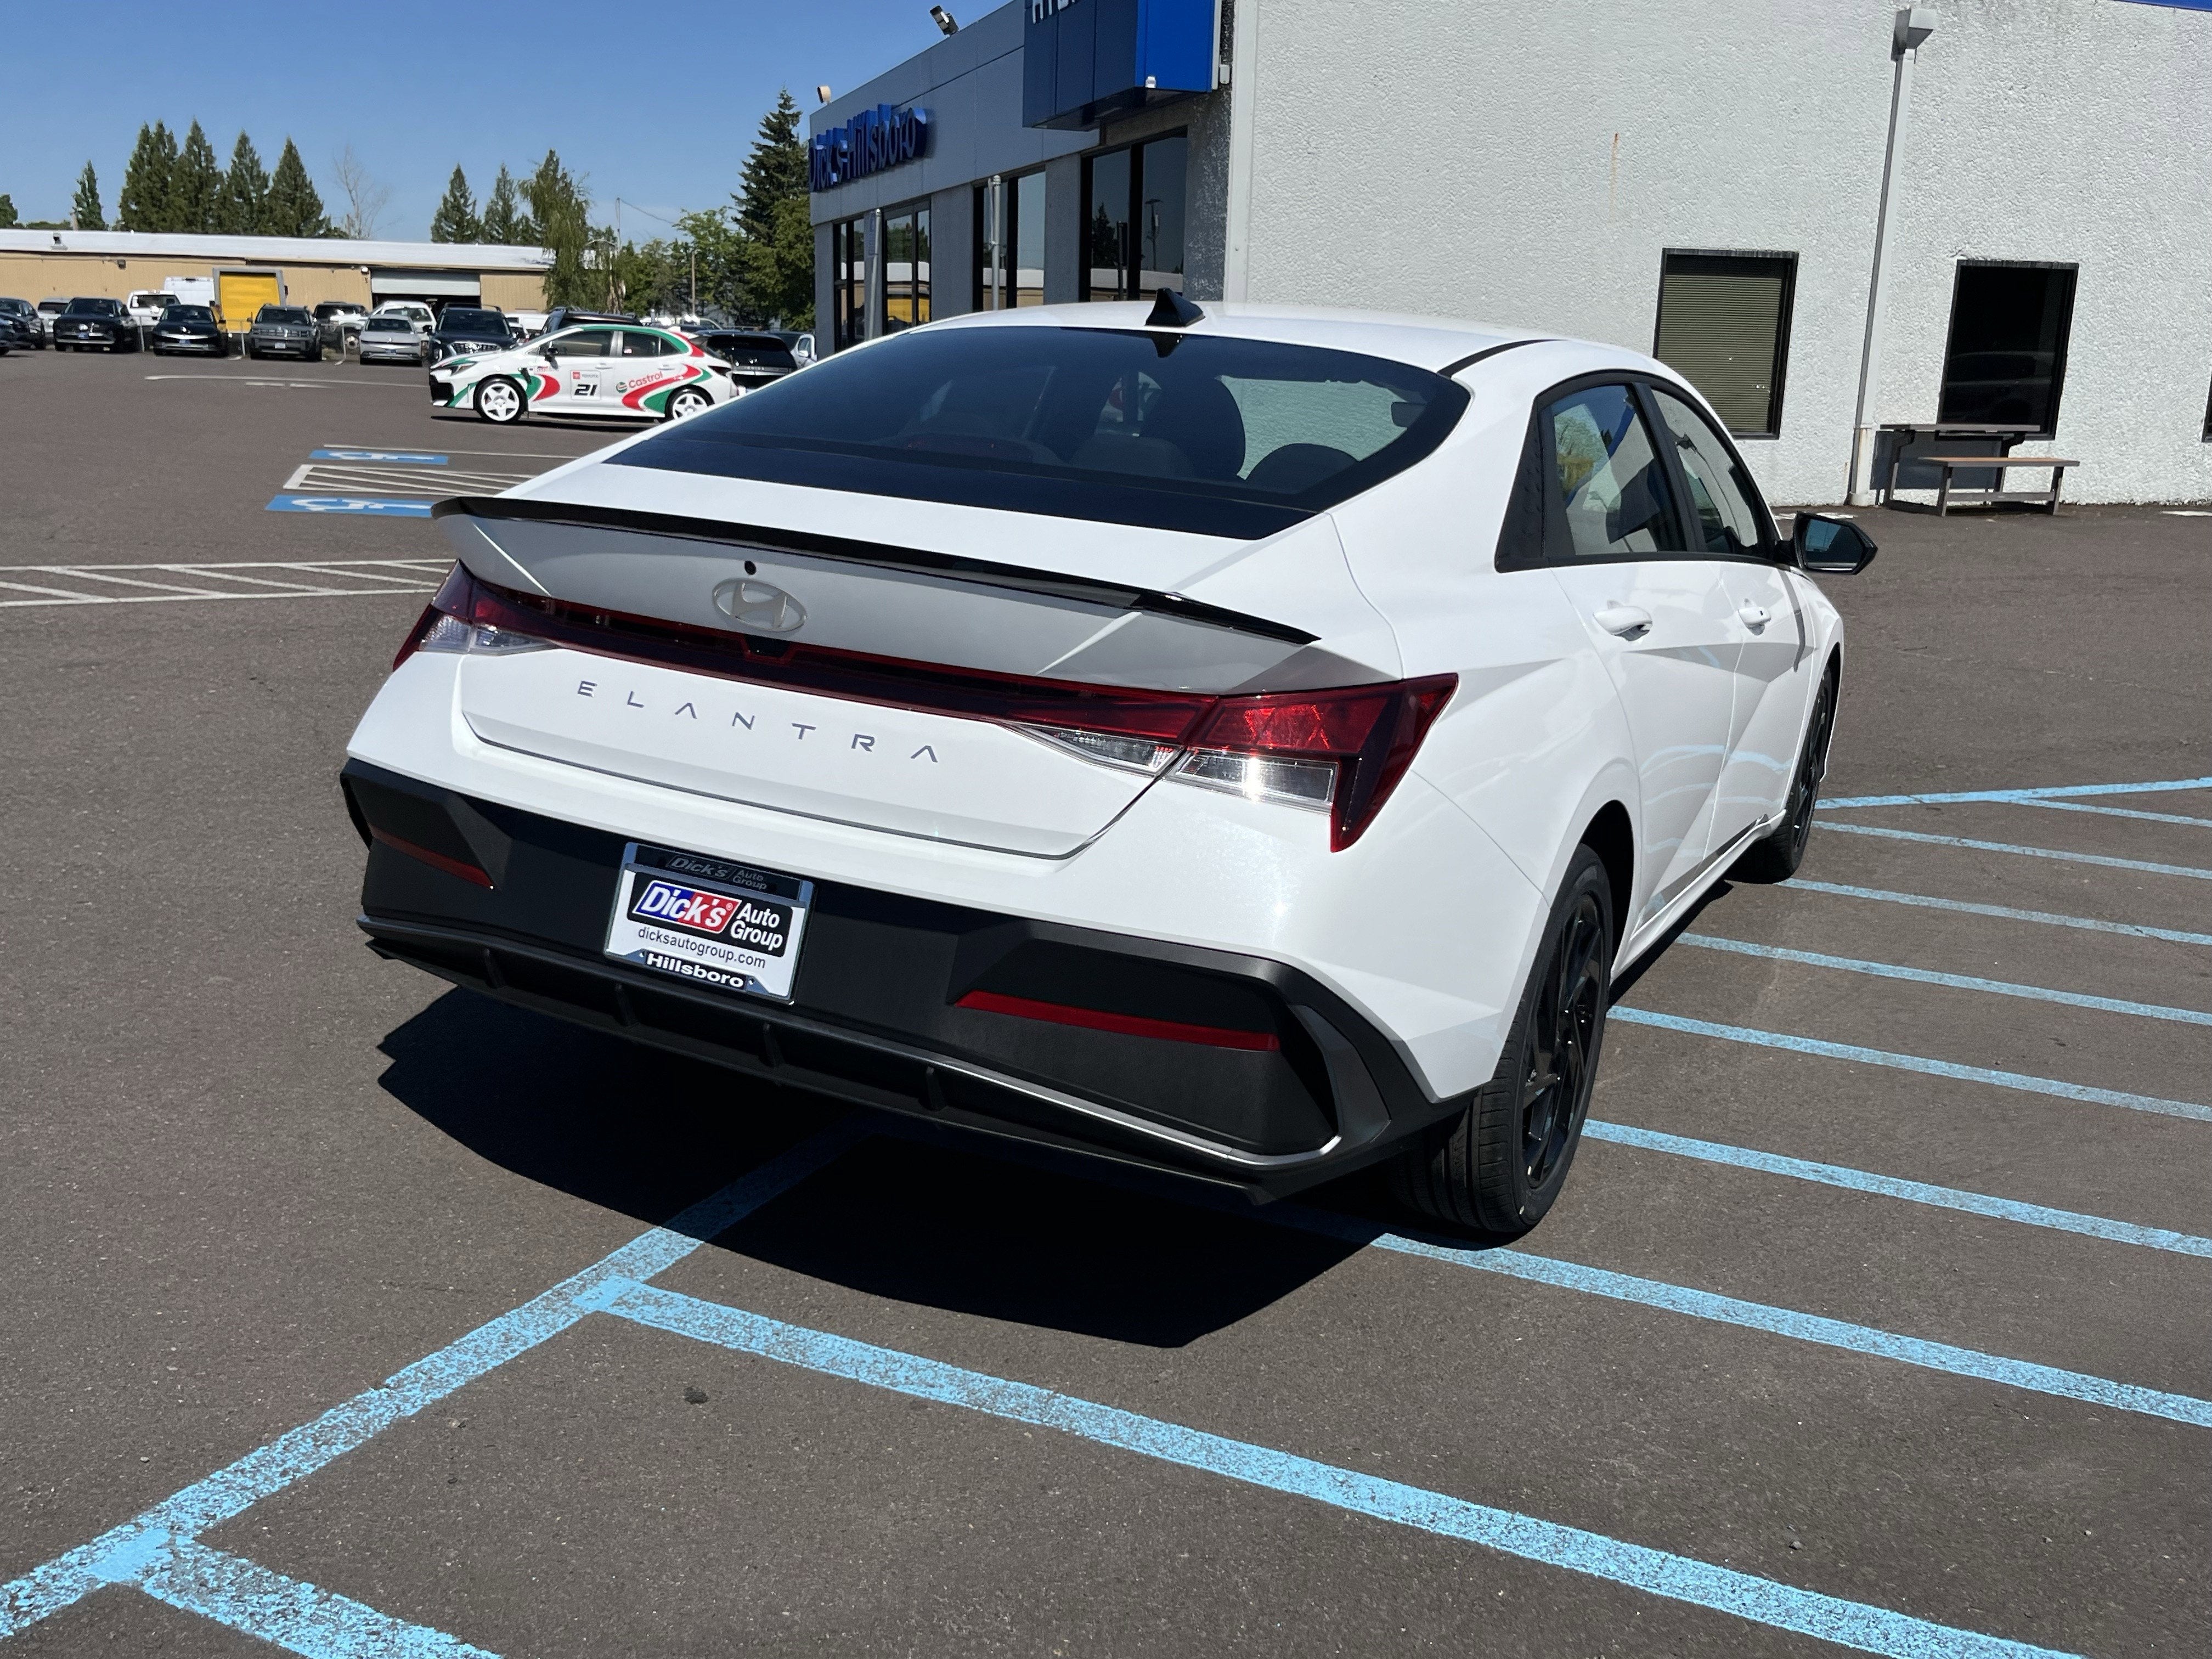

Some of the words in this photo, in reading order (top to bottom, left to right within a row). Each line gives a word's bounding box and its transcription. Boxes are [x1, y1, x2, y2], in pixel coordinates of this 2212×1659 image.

[574, 384, 598, 396] 21
[629, 370, 663, 388] Castrol
[577, 680, 939, 763] ELANTRA
[670, 857, 729, 878] Dick's
[737, 870, 764, 881] Auto
[732, 876, 768, 890] Group
[640, 885, 727, 928] Dick's
[736, 902, 781, 928] Auto
[638, 926, 766, 969] dicksautogroup.com
[730, 921, 783, 951] Group
[646, 952, 744, 988] Hillsboro
